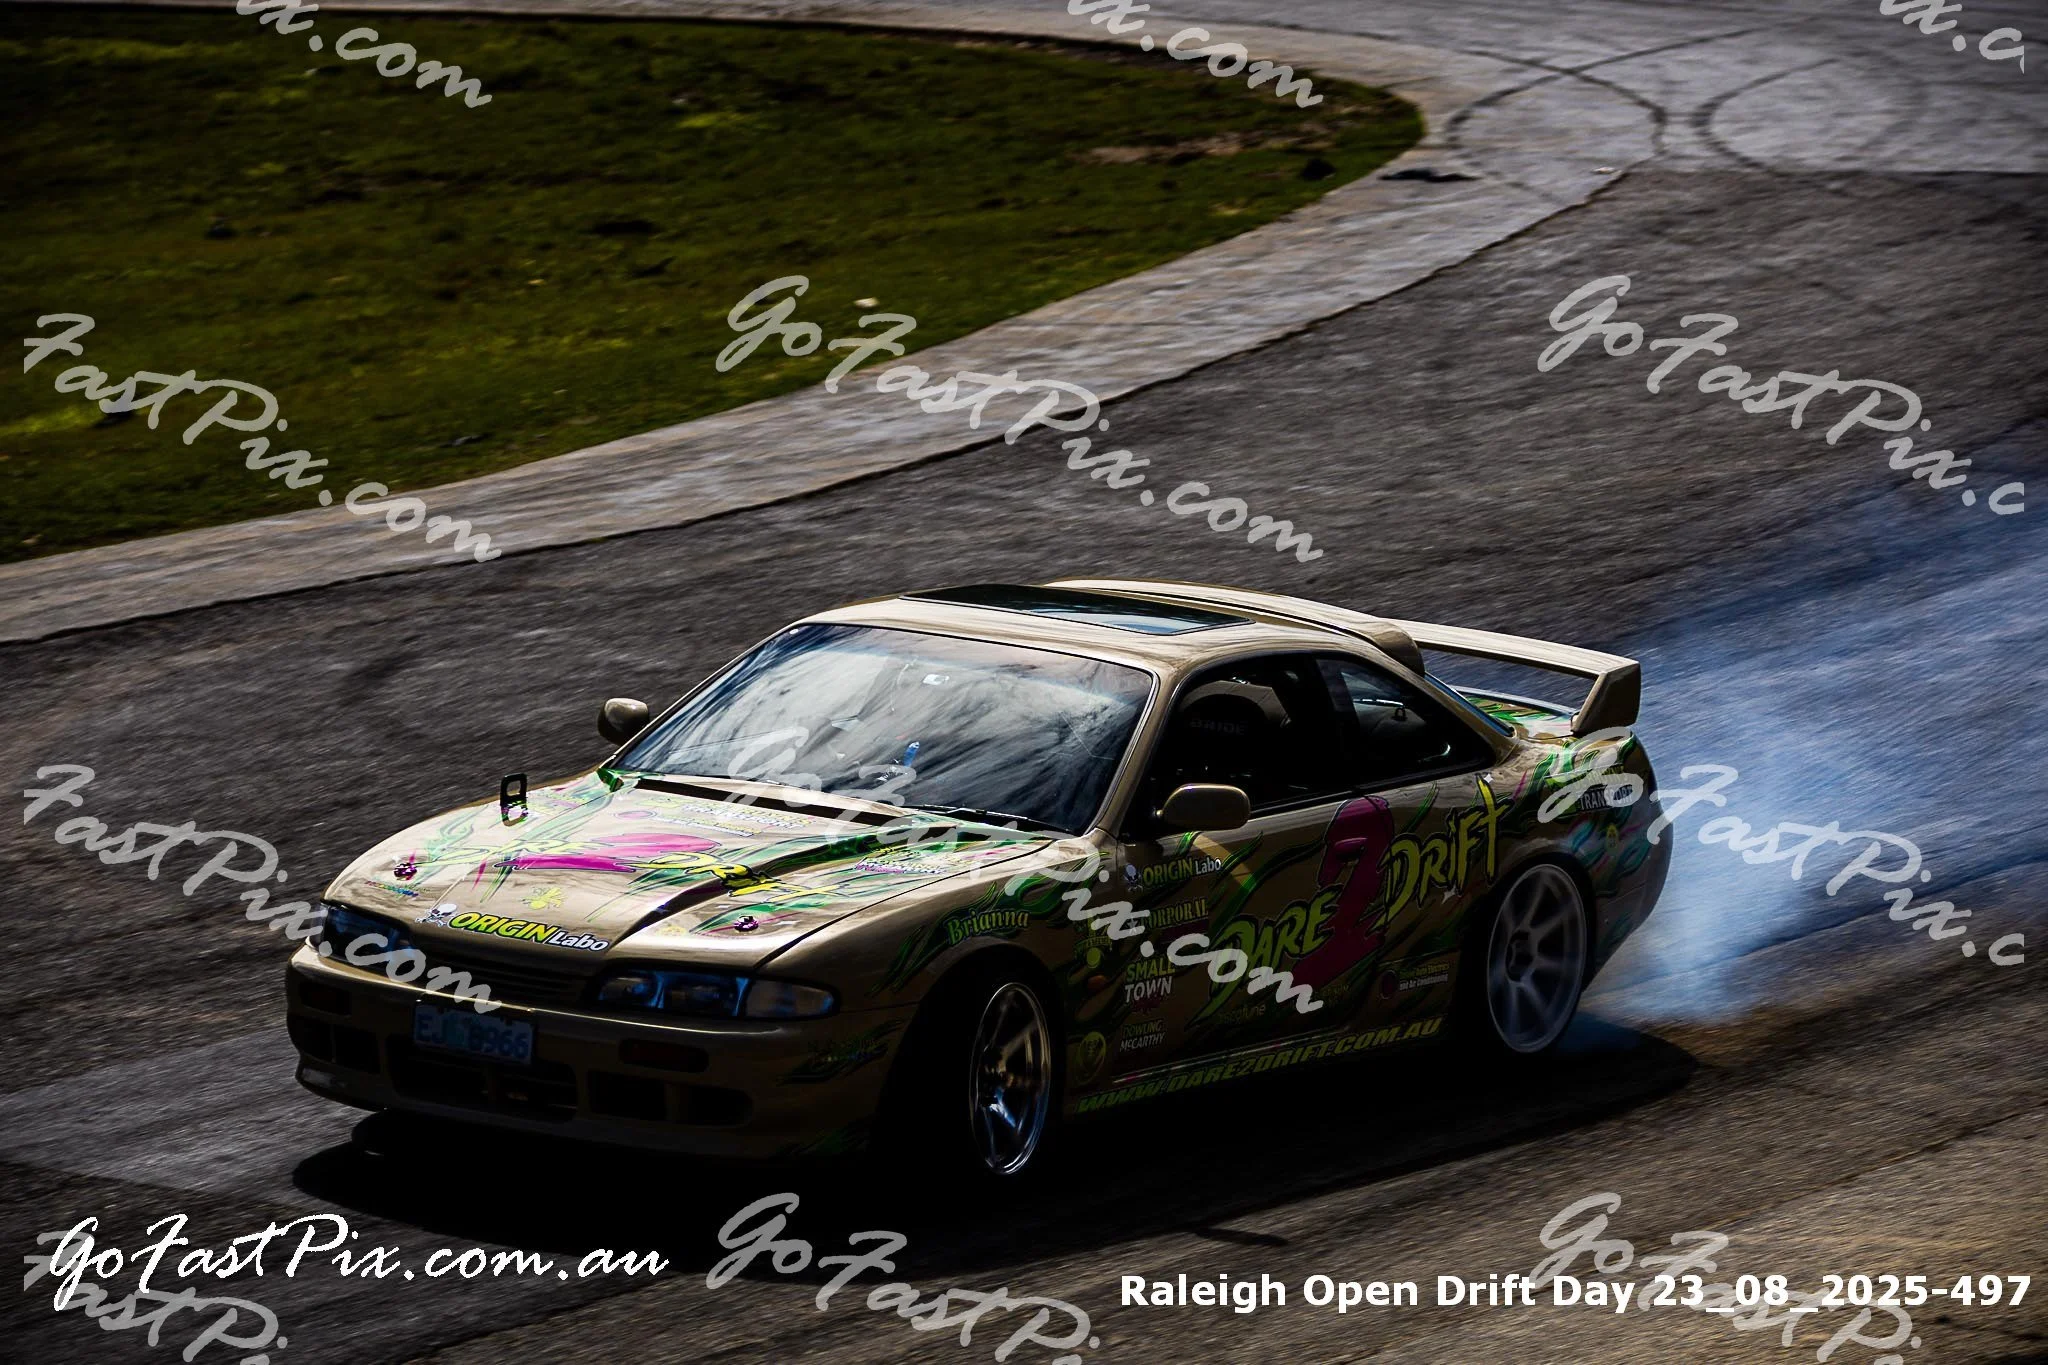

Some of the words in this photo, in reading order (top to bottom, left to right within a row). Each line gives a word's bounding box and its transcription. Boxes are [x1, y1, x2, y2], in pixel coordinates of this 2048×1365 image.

[1142, 856, 1194, 887] ORIGIN
[1194, 857, 1222, 877] Labo
[1185, 885, 1344, 1031] DARE
[1362, 773, 1515, 937] DRIFT
[449, 911, 557, 945] ORIGIN
[547, 930, 610, 953] Labo
[945, 908, 1031, 946] Brianna
[1125, 957, 1177, 981] SMALL
[1123, 975, 1173, 1004] TOWN
